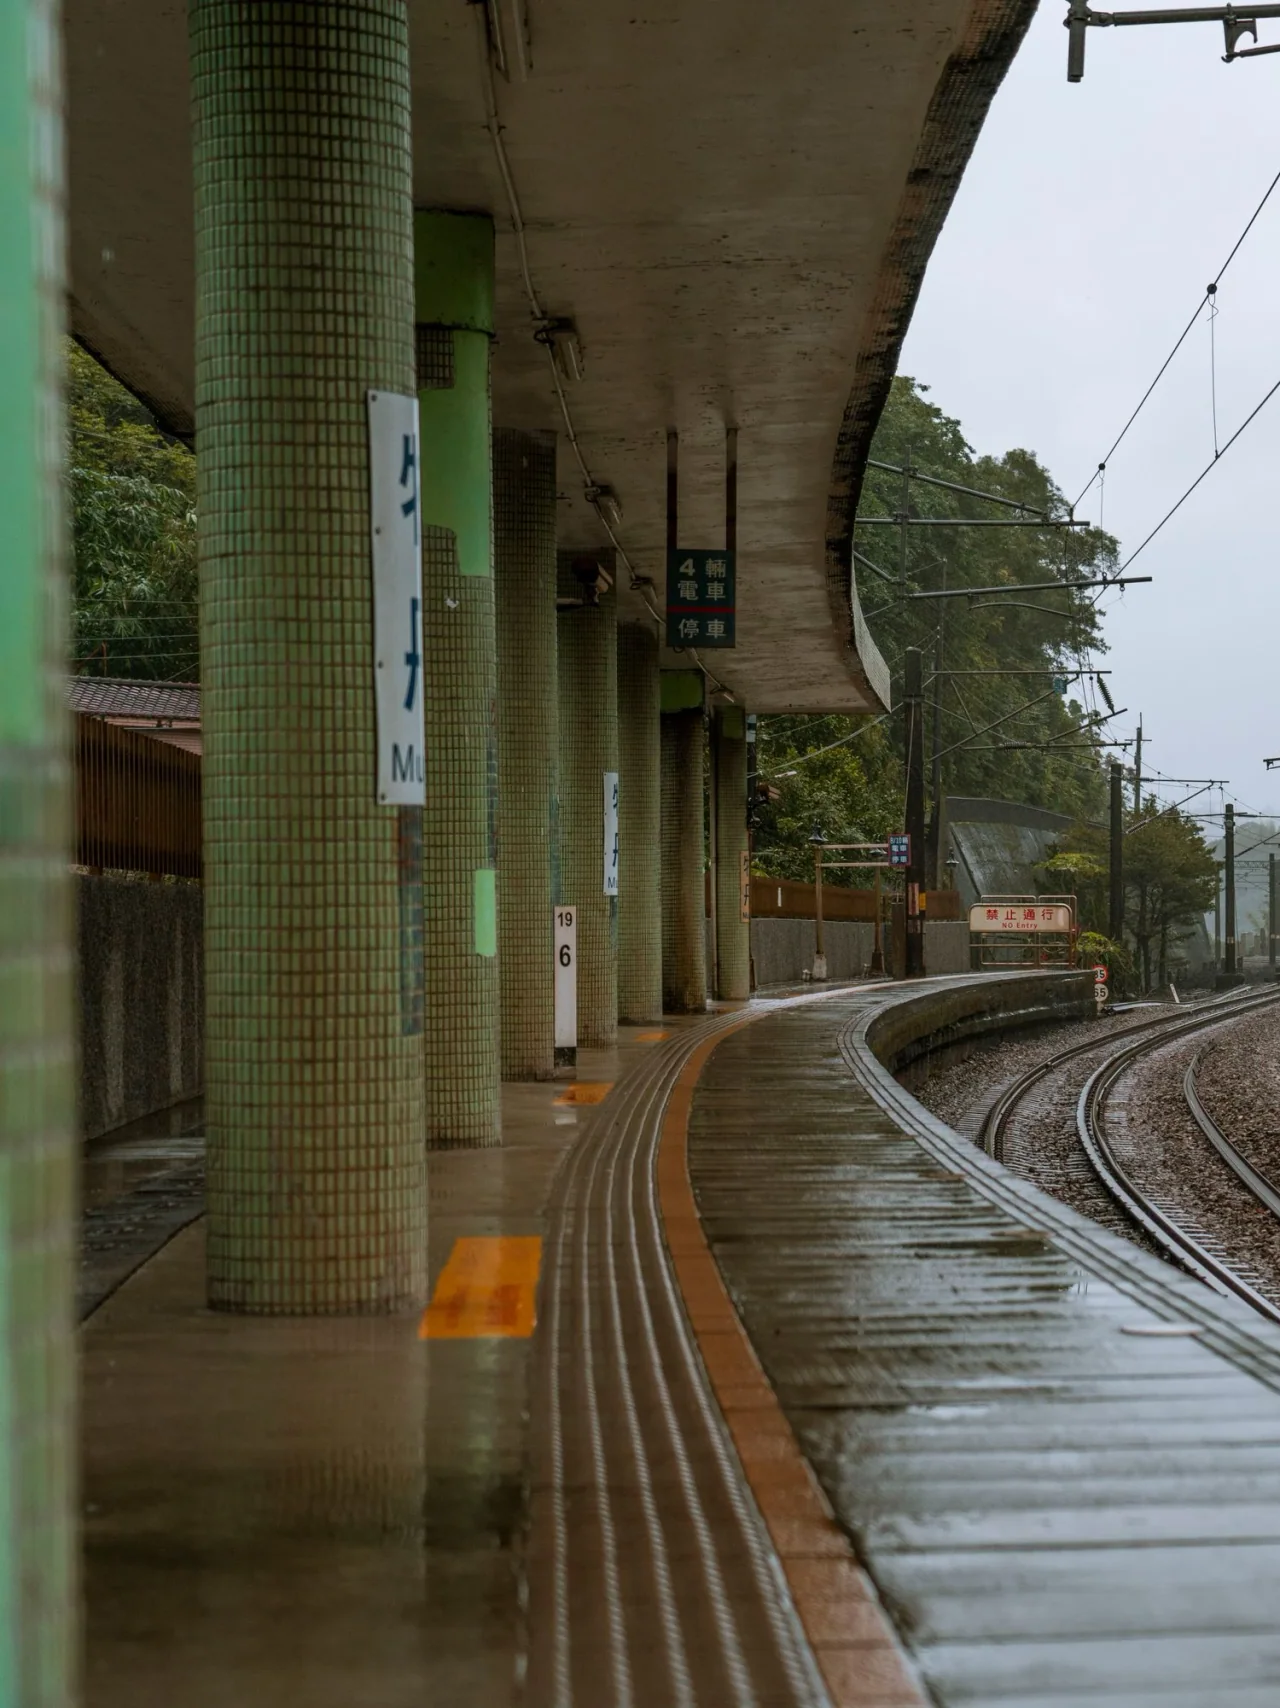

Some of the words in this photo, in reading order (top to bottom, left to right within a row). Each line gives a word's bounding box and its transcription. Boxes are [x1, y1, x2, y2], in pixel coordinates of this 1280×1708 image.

[678, 581, 726, 601] 電車
[678, 618, 726, 639] 停車
[557, 911, 573, 927] 19
[986, 908, 1053, 921] 禁止通行
[559, 944, 571, 967] 6
